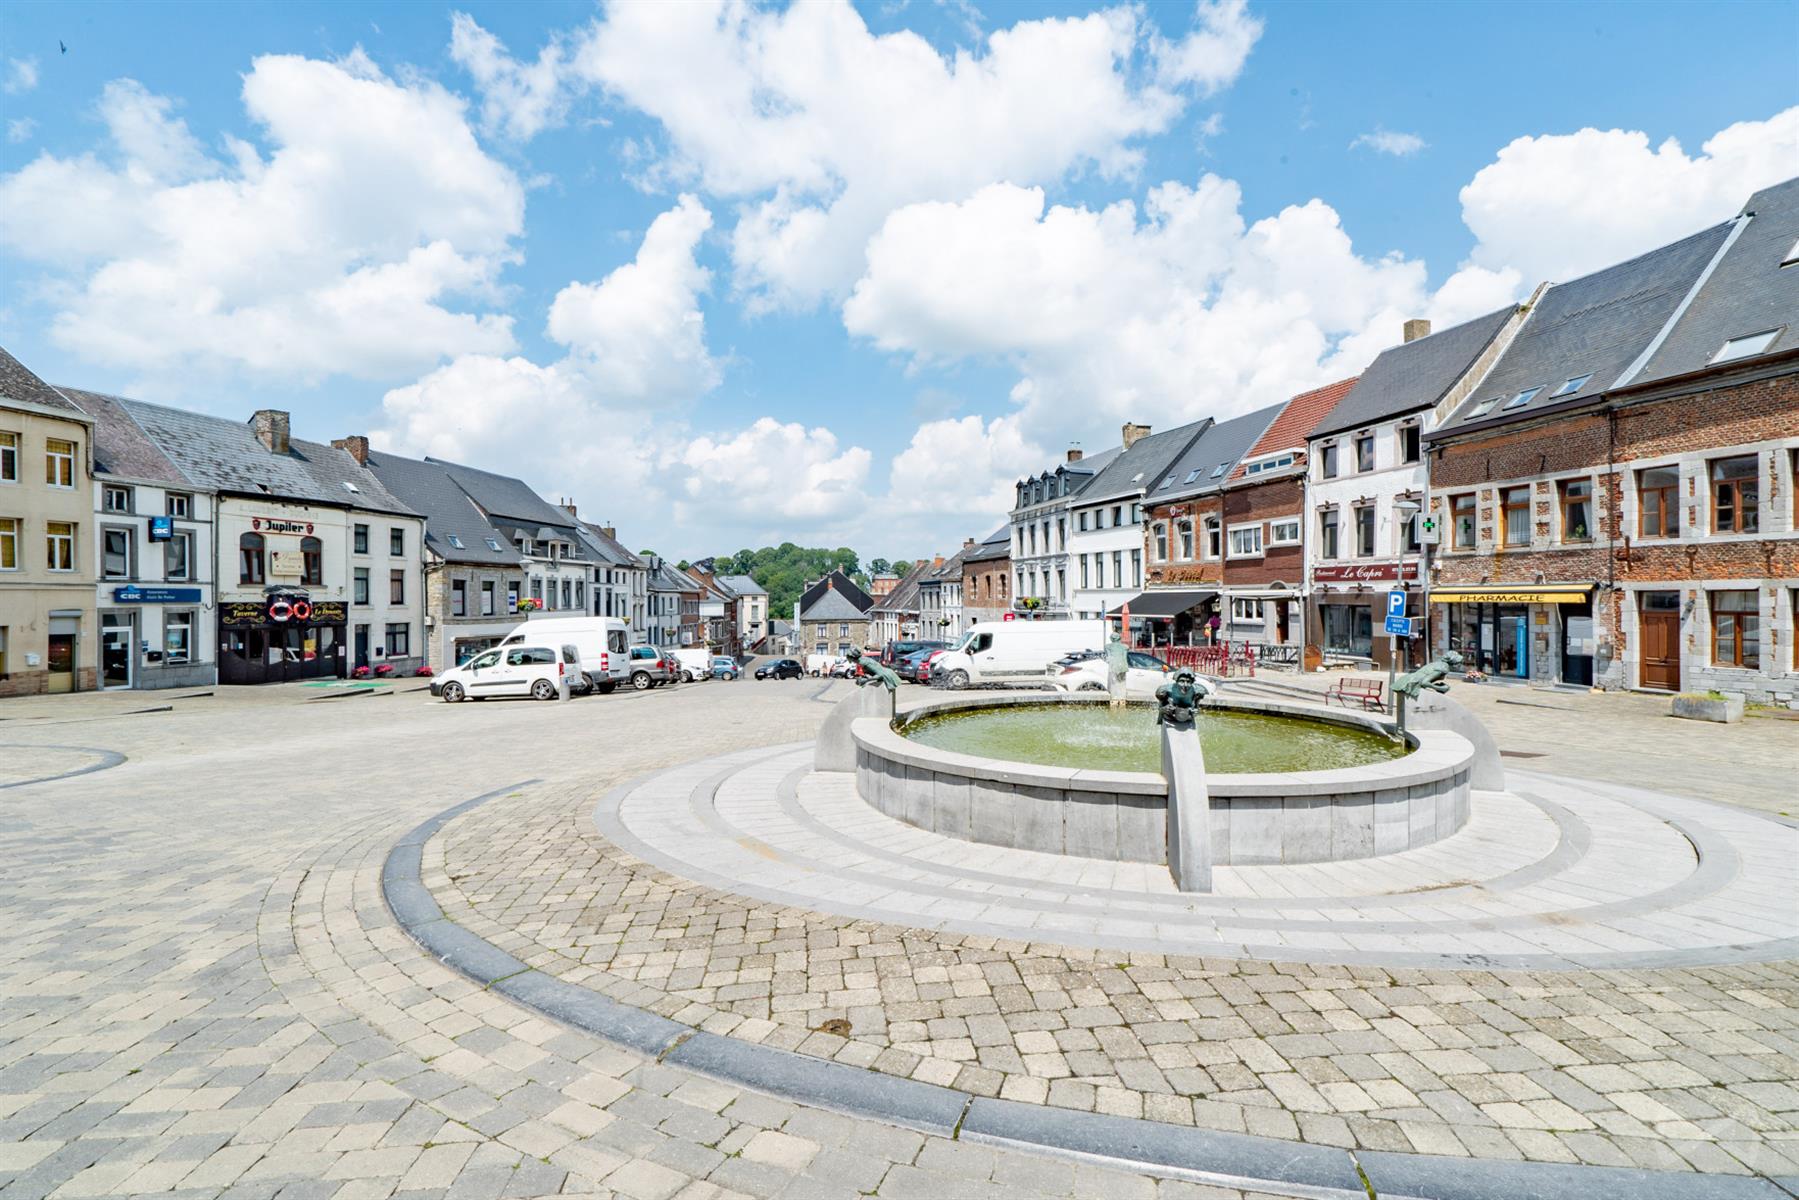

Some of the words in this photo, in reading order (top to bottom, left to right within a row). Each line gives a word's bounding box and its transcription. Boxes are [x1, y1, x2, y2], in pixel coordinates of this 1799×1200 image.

[265, 520, 304, 533] Jupiler
[1340, 566, 1355, 578] Le
[1356, 565, 1384, 580] Capri
[1390, 594, 1403, 613] P
[1459, 594, 1545, 602] PHARMACIE
[232, 609, 258, 618] Taverne
